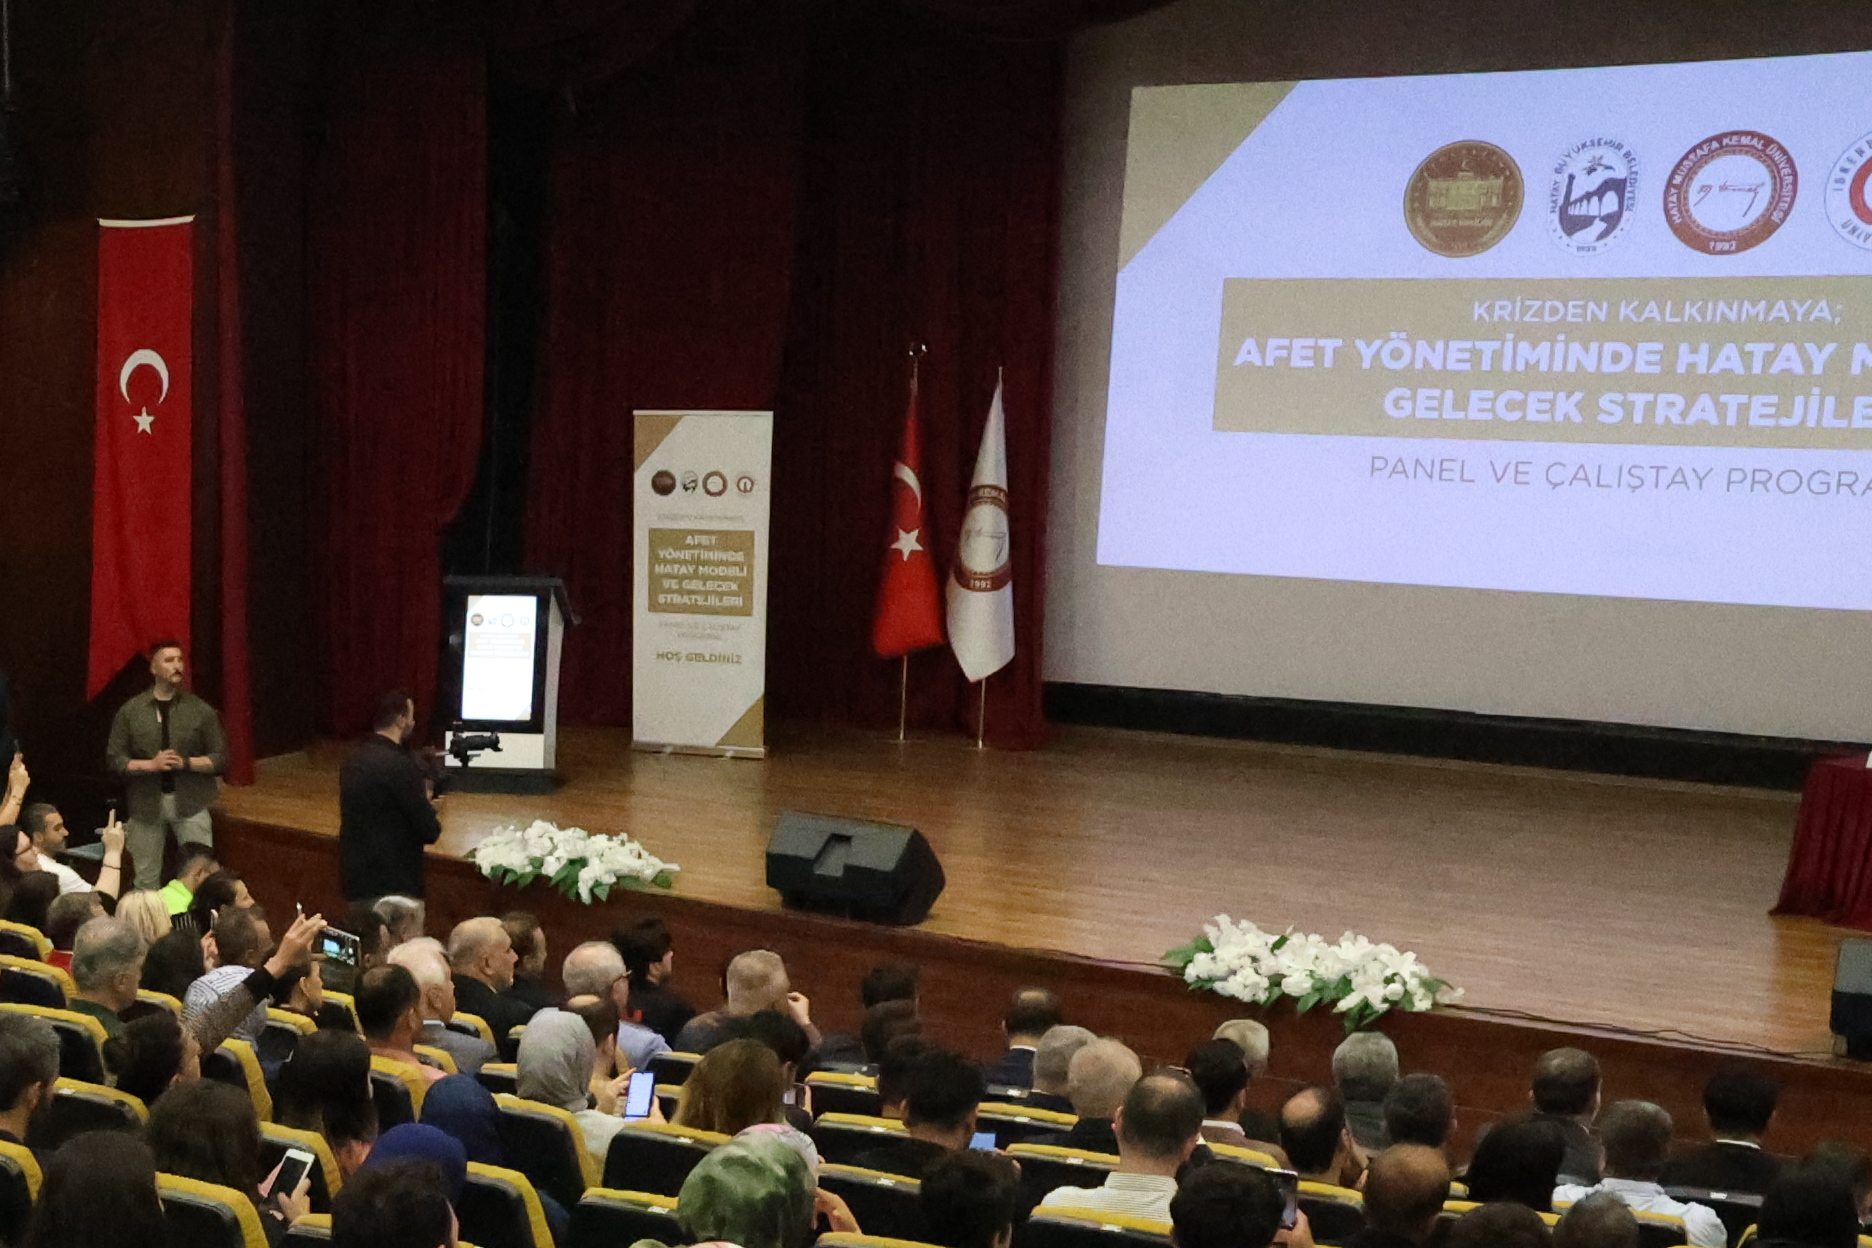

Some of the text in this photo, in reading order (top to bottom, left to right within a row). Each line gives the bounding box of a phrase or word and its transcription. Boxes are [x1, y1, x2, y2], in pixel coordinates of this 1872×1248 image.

[1722, 135, 1765, 150] KEMAL
[1473, 297, 1608, 323] KRİZDEN
[1233, 338, 1343, 368] AFET
[1354, 331, 1664, 375] YÖNETİMİNDE
[1675, 342, 1839, 376] HATAY
[1383, 387, 1584, 424] GELECEK
[1369, 455, 1476, 485] PANEL
[1489, 461, 1532, 486] VE
[1544, 462, 1714, 494] ÇALIŞTAY
[654, 563, 696, 576] HATAY
[662, 579, 680, 590] VE
